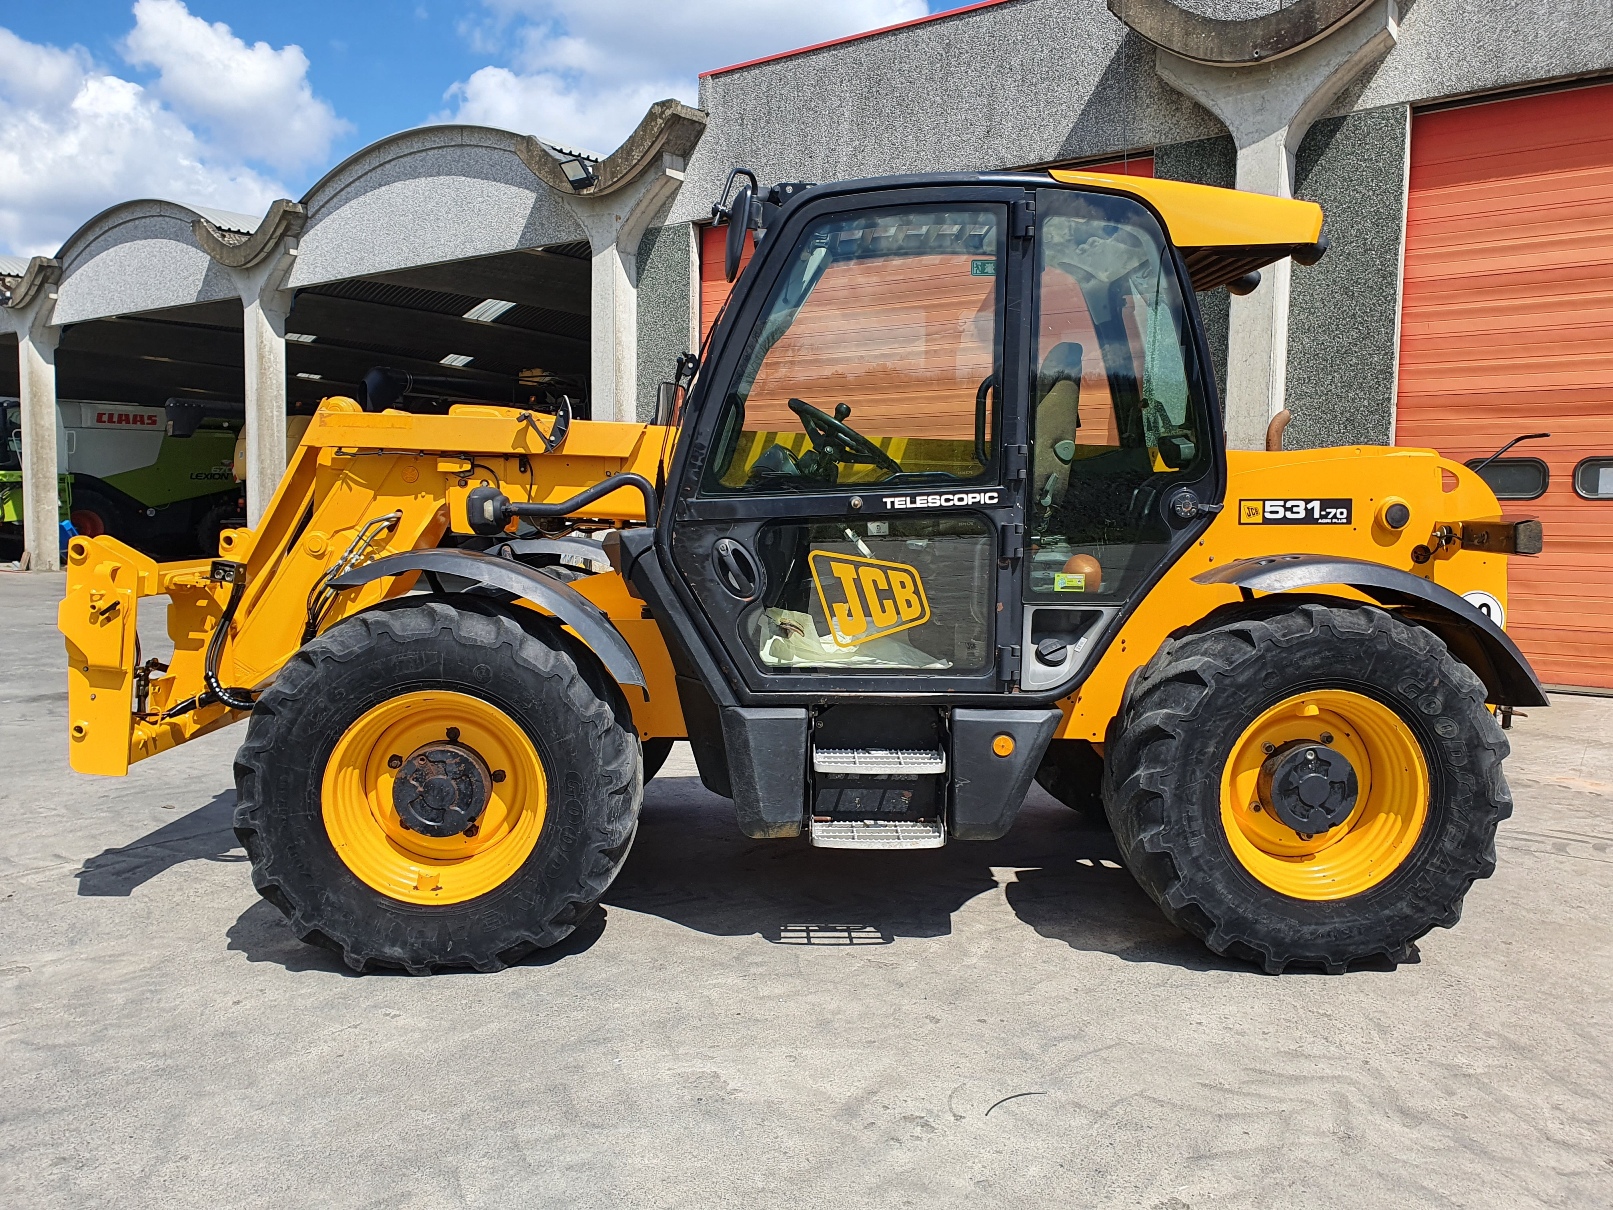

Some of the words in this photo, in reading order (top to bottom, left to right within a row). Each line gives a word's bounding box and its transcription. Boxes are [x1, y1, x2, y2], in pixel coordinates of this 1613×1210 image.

[96, 412, 158, 426] CLAAS
[190, 472, 229, 480] LEXION
[882, 492, 999, 510] TELESCOPIC
[1246, 506, 1260, 518] JCB
[1264, 500, 1348, 519] 531-70
[830, 561, 922, 637] JCB
[1397, 676, 1476, 904] GOODYEAR
